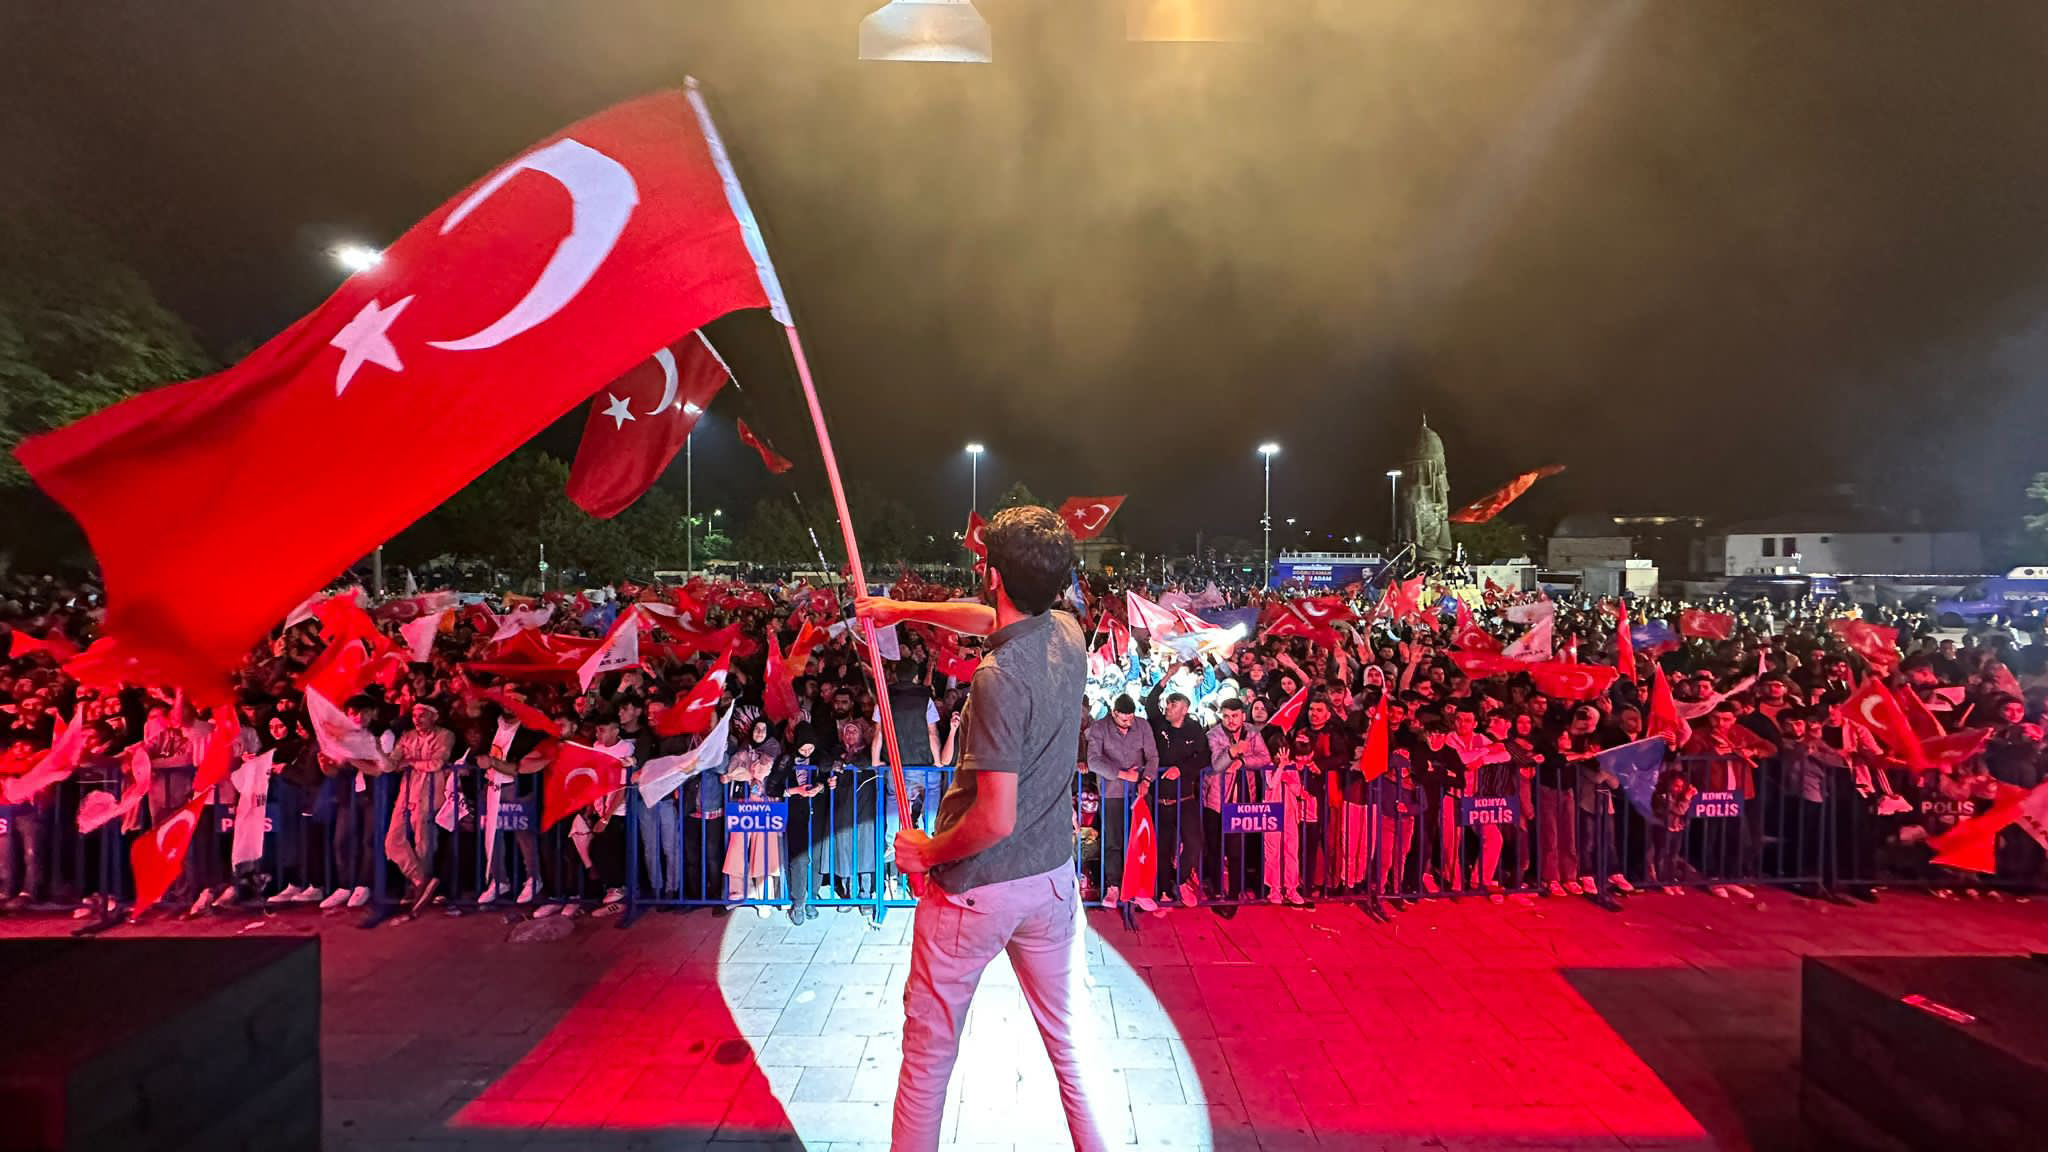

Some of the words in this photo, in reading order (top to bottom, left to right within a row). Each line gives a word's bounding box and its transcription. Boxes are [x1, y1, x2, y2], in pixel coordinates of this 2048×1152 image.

[1702, 792, 1734, 801] KONYA
[1474, 798, 1507, 808] KONYA
[738, 804, 772, 813] KONYA
[1237, 804, 1271, 814] KONYA
[727, 813, 784, 831] POLİS
[1231, 813, 1278, 831] POLİS
